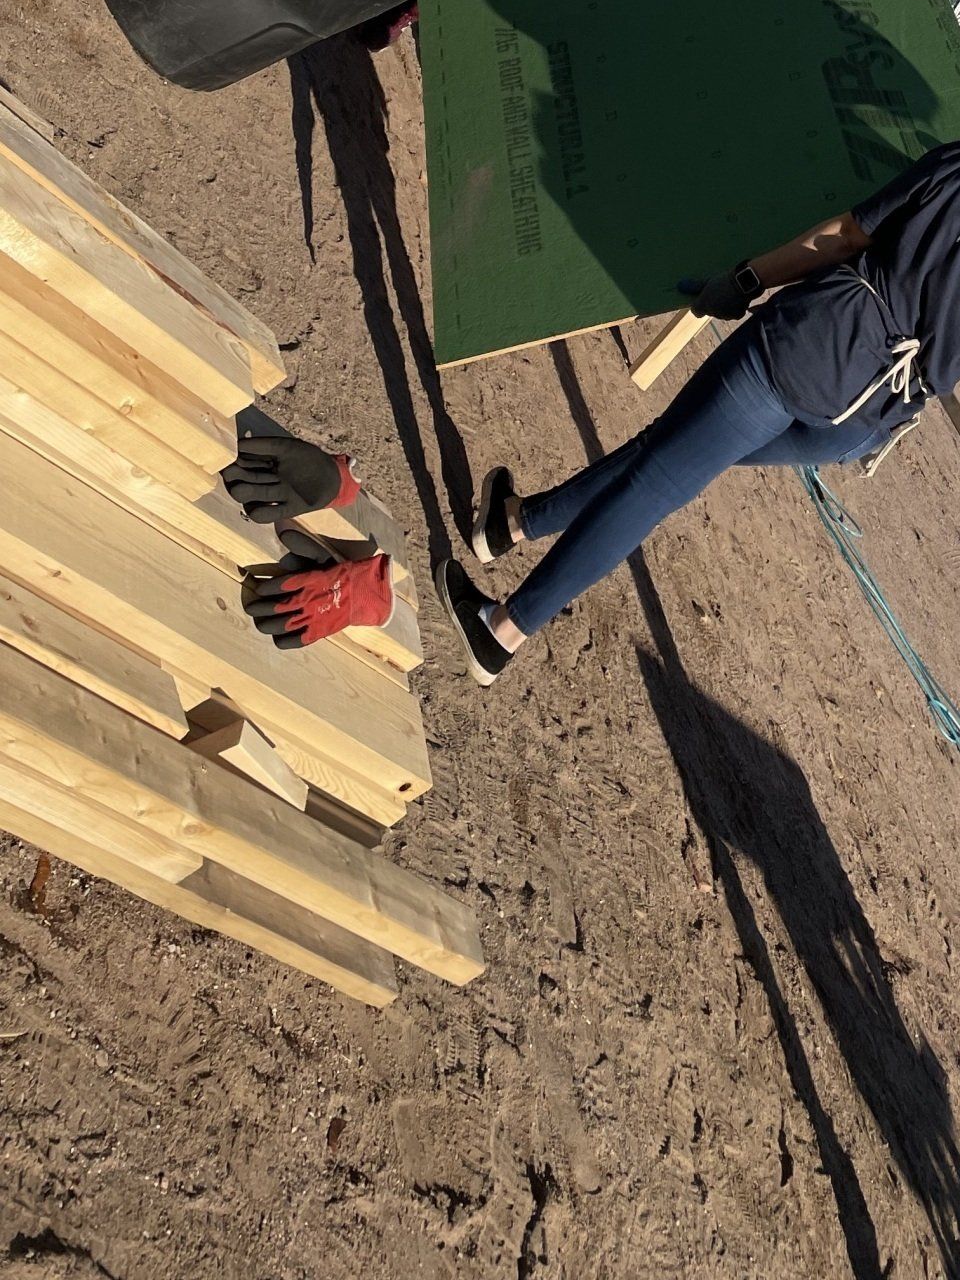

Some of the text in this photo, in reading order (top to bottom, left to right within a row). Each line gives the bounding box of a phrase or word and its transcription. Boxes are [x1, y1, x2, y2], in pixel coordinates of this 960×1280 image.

[498, 57, 524, 92] ROOF
[504, 121, 533, 166] WALL
[511, 166, 543, 257] SHEATHING
